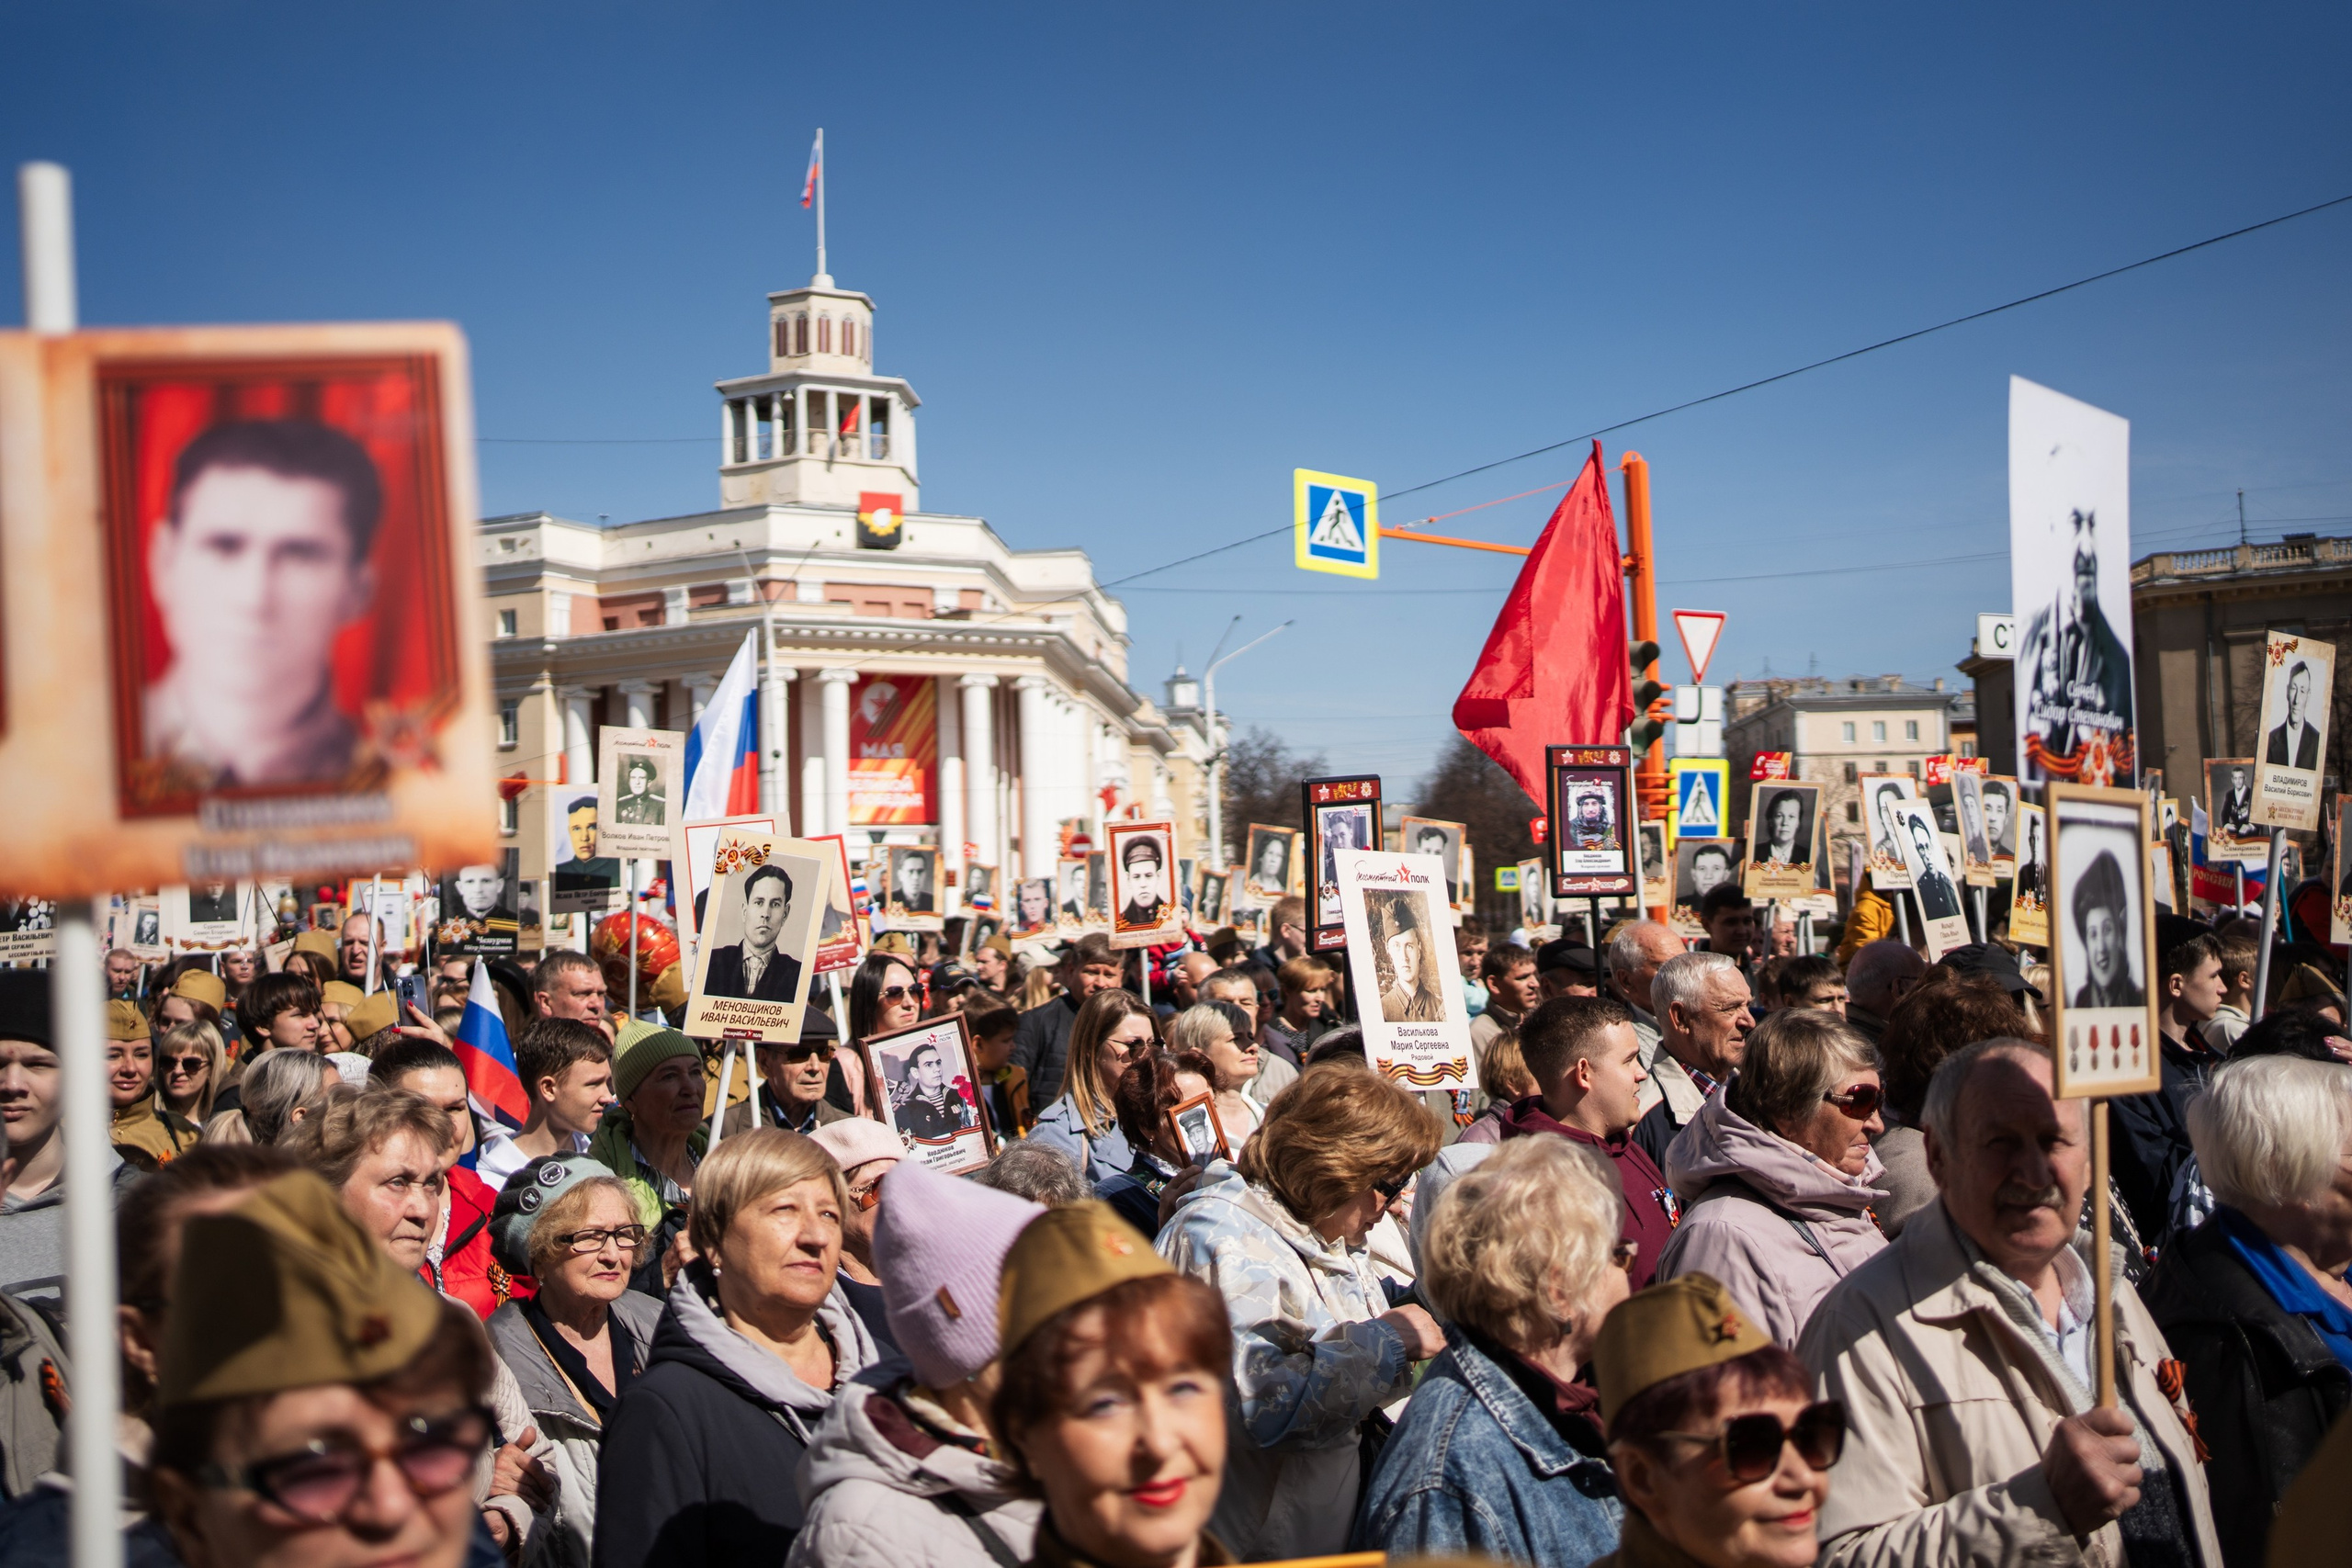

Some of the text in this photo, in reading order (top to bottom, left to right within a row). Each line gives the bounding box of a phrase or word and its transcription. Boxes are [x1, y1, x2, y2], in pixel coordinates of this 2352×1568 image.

[860, 741, 906, 758] МАЯ
[2273, 774, 2308, 787] ВЛАДИМИРОВ
[2264, 784, 2312, 797] Василий Борисович
[2192, 867, 2234, 889] РОССИЯ
[712, 1000, 783, 1016] МЕНОВЩИКОВ
[700, 1011, 790, 1028] ИВАН ВАСИЛЬЕВИЧ
[1396, 1026, 1439, 1037] Василькова
[1390, 1039, 1450, 1053] Мария Сергеевна
[933, 1148, 967, 1163] Григорьевич
